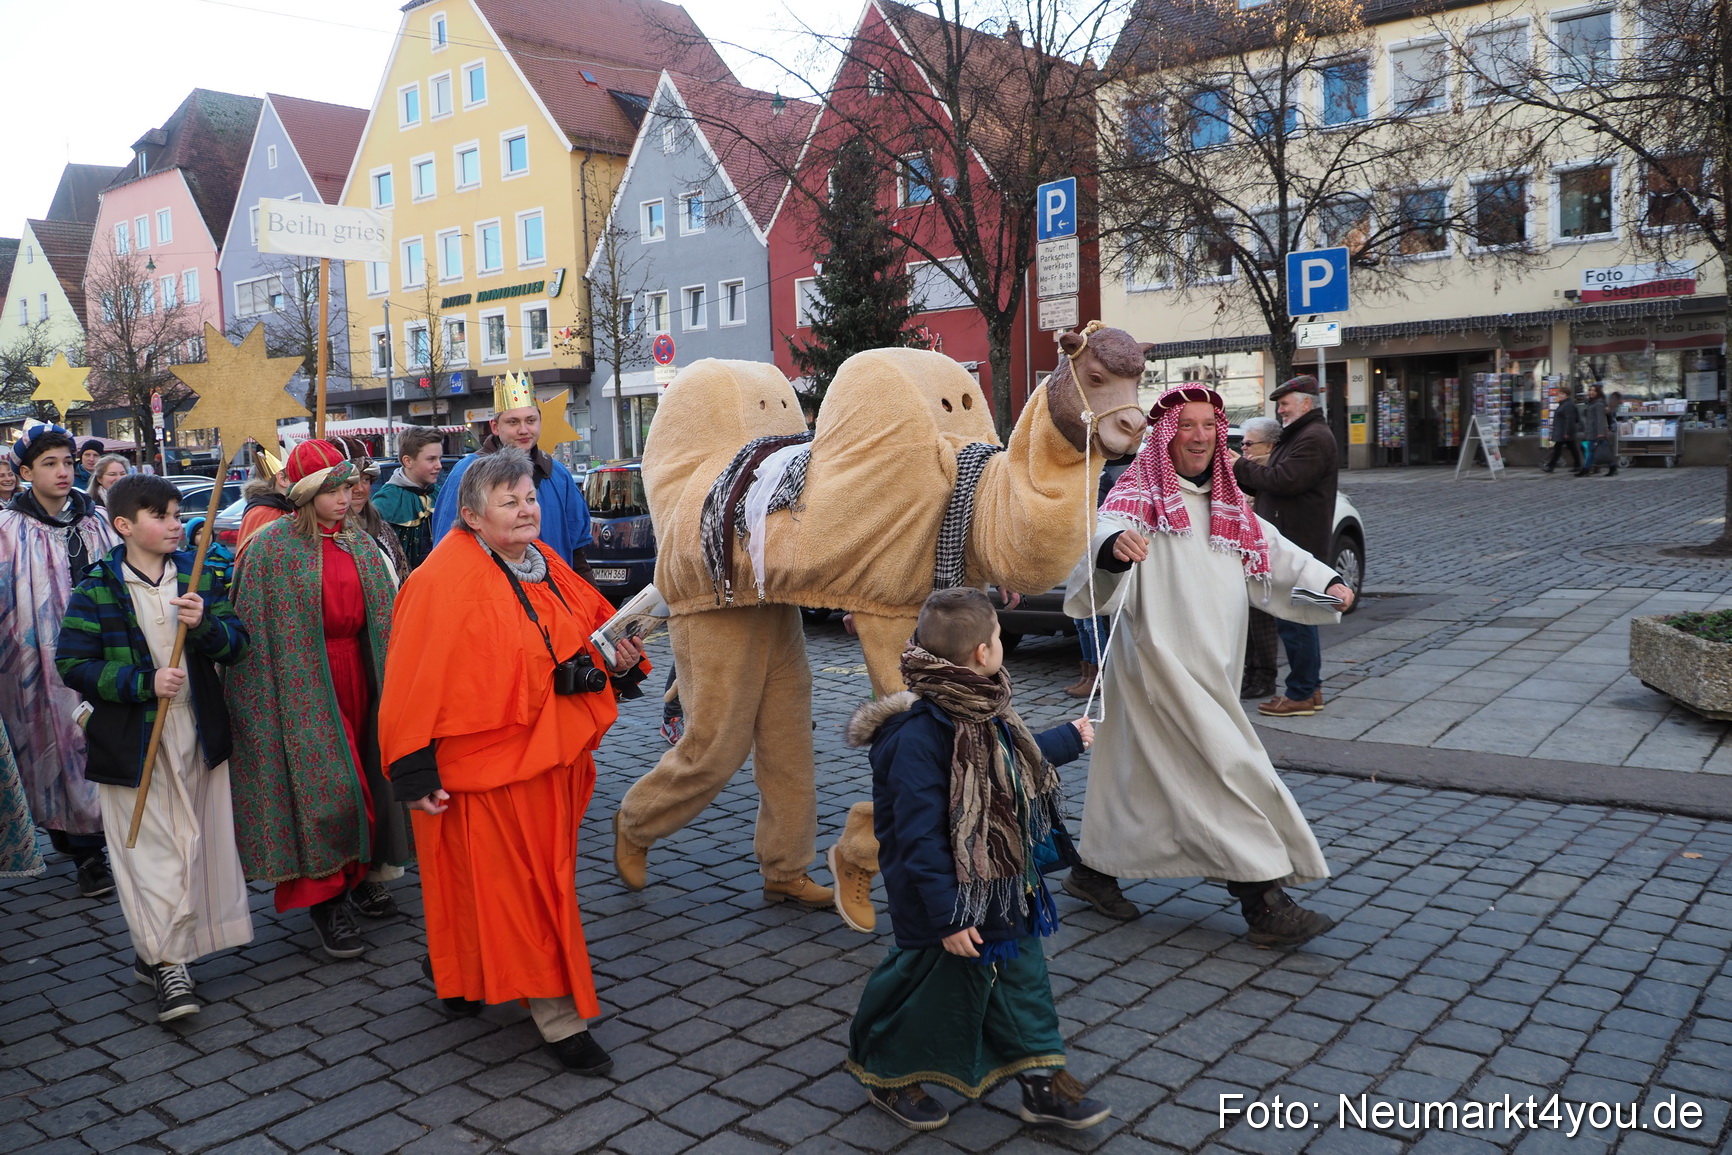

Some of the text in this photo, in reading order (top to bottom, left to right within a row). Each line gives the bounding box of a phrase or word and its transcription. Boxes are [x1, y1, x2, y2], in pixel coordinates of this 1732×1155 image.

[1046, 188, 1067, 233] P
[333, 220, 385, 244] gries
[1045, 243, 1069, 253] nur mit
[1040, 252, 1075, 263] Parkschein
[1043, 261, 1073, 271] werktags
[1585, 269, 1623, 283] Foto
[1301, 258, 1334, 307] P
[476, 280, 545, 303] IMMOBILIEN
[1602, 280, 1691, 298] Stegmeier
[1576, 326, 1647, 339] Foto Studio
[1656, 321, 1684, 333] Foto
[1513, 334, 1543, 344] Shop
[1352, 374, 1363, 382] 26
[613, 569, 626, 579] 368
